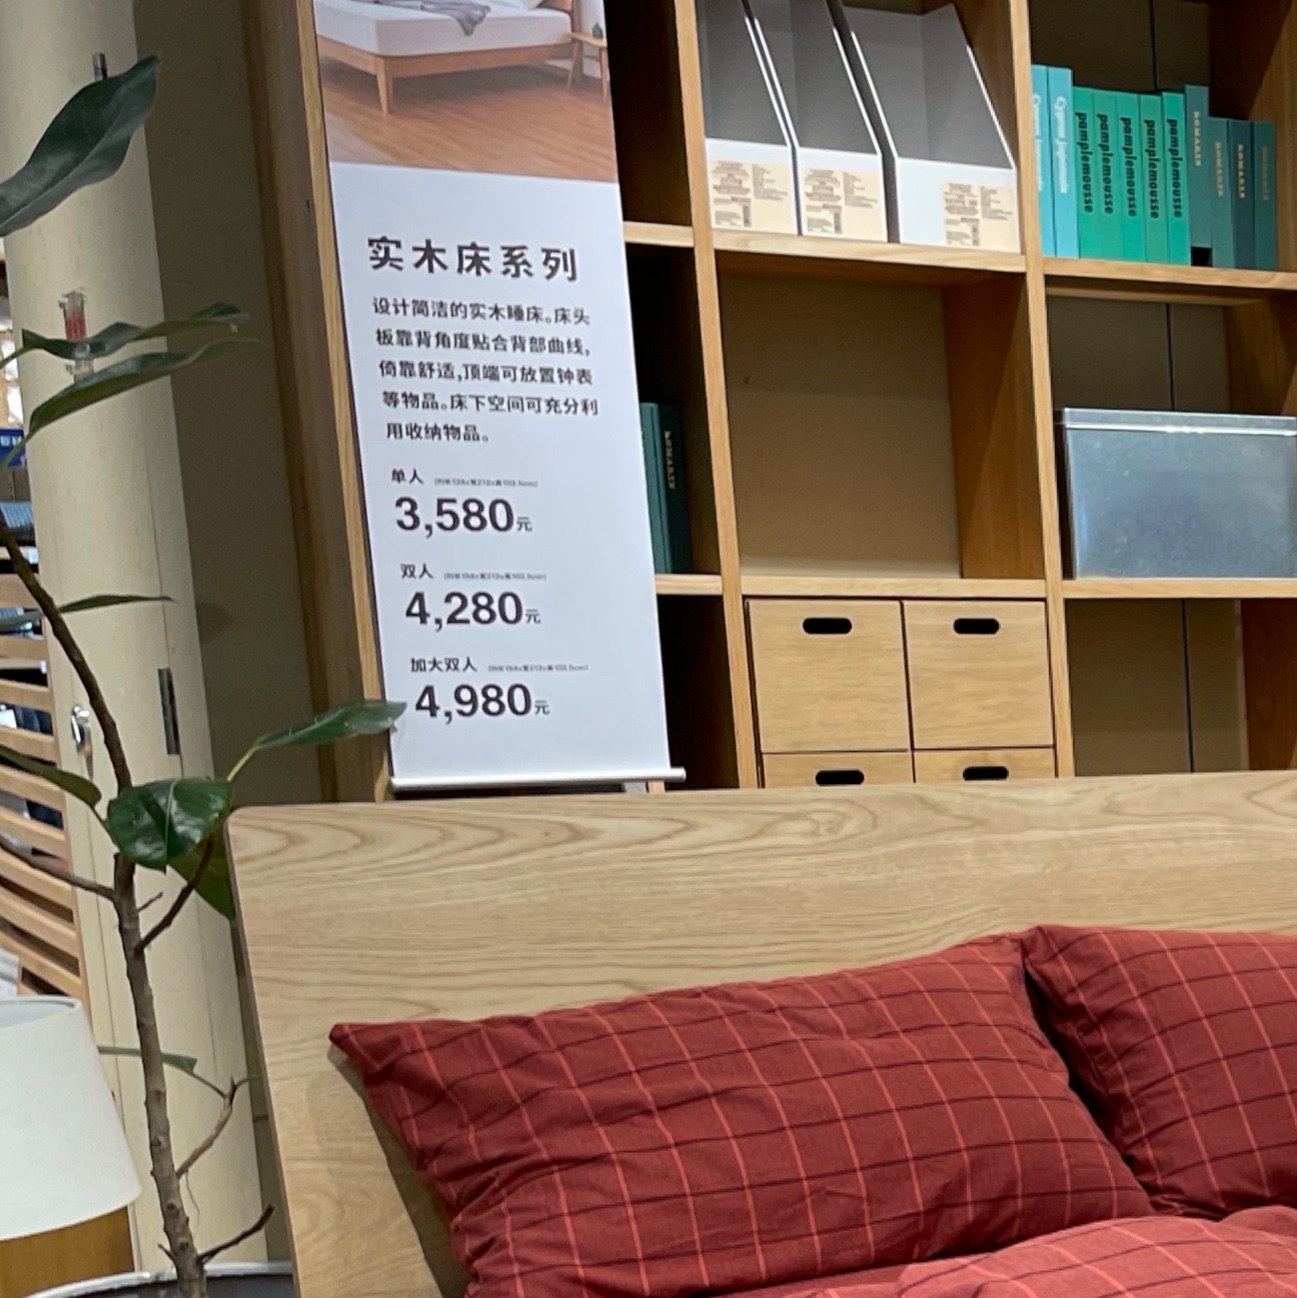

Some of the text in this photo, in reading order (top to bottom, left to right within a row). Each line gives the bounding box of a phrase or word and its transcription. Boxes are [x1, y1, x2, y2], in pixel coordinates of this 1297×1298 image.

[1075, 112, 1093, 213] pamplemousse
[1097, 113, 1114, 214] pamplemousse
[1120, 117, 1137, 217] pamplemousse
[1144, 119, 1161, 219] pamplemousse
[1166, 118, 1183, 218] pamplemousse
[367, 236, 578, 281] 实木床系列
[372, 297, 591, 325] 设计简洁的实木睡床。床头
[376, 328, 591, 357] 板靠背角度贴合背部曲线，
[379, 360, 594, 387] 倚靠舒适，顶端可放置钟表
[382, 391, 599, 416] 等物品。床下空间可充分利
[386, 422, 490, 443] 用收纳物品。
[391, 468, 424, 485] 单人
[394, 496, 533, 538] 3,580元
[400, 563, 434, 580] 双人
[405, 590, 541, 632] 4,280元
[410, 656, 478, 673] 加大双人
[415, 683, 550, 725] 4,980元
